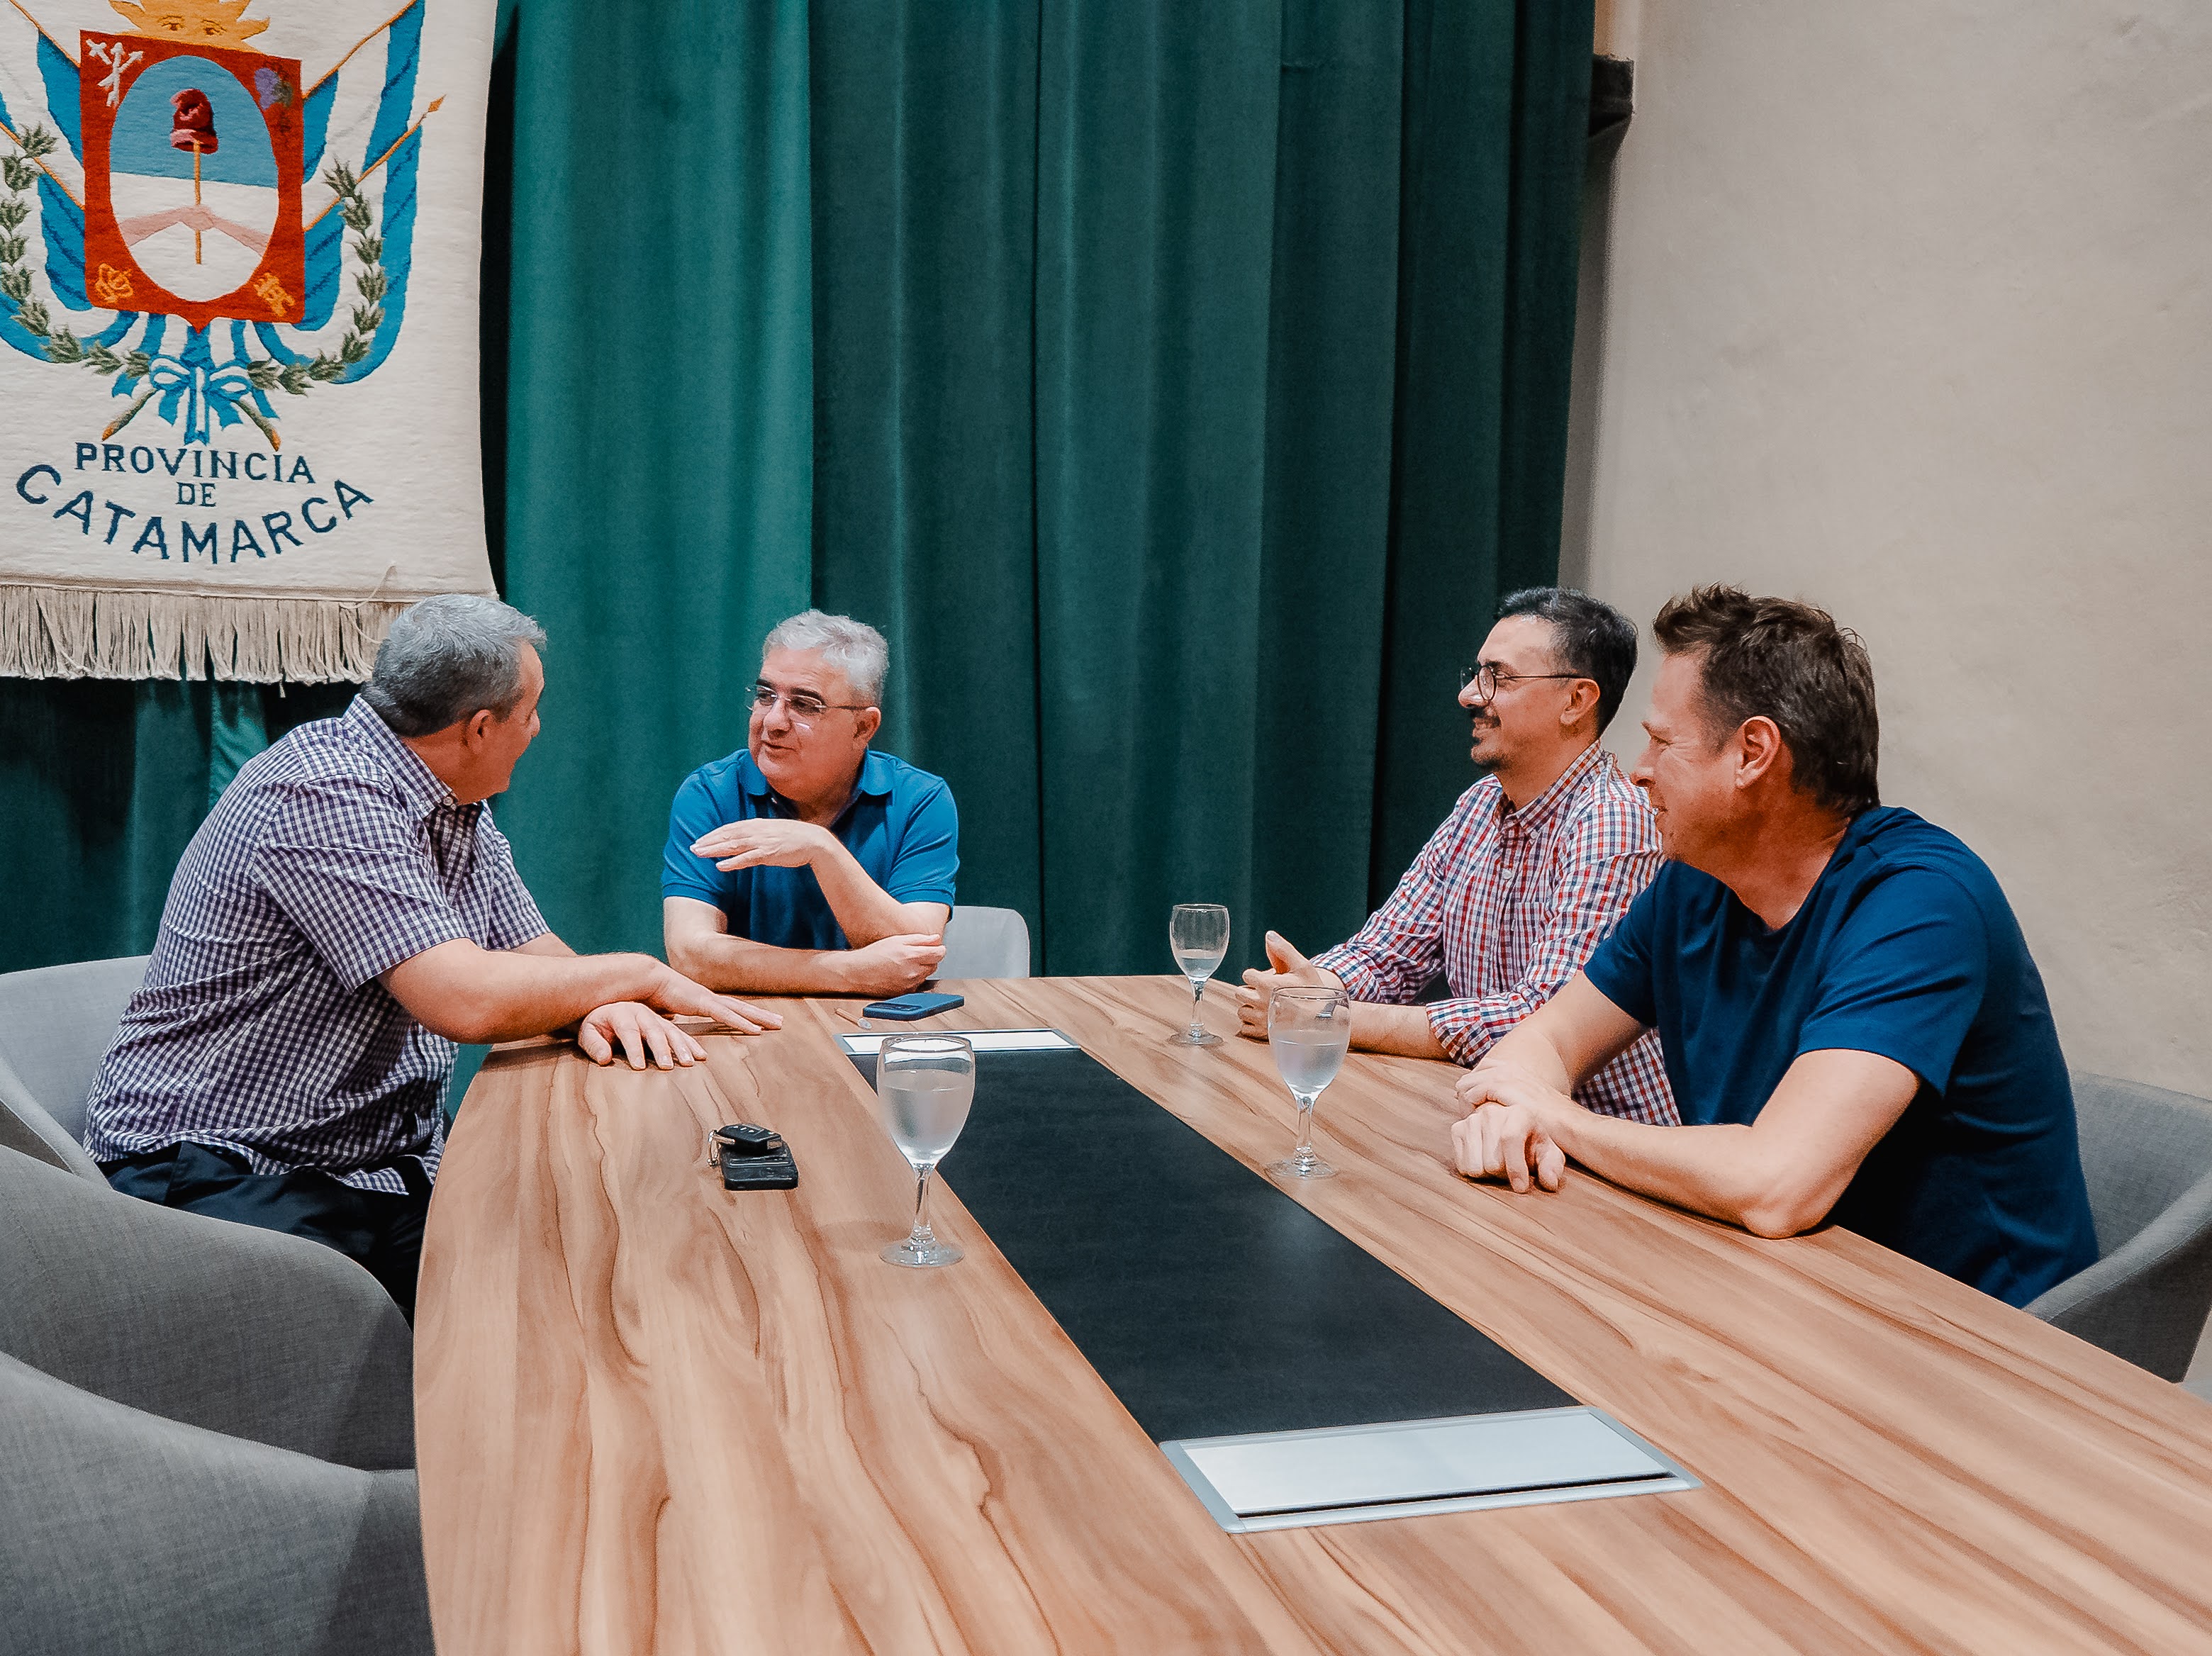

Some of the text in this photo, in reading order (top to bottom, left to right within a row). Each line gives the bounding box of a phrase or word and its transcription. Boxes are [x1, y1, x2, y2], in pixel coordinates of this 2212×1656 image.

[74, 442, 315, 483] PROVINCIA
[16, 464, 374, 564] CATAMARCA
[176, 481, 216, 507] DE
